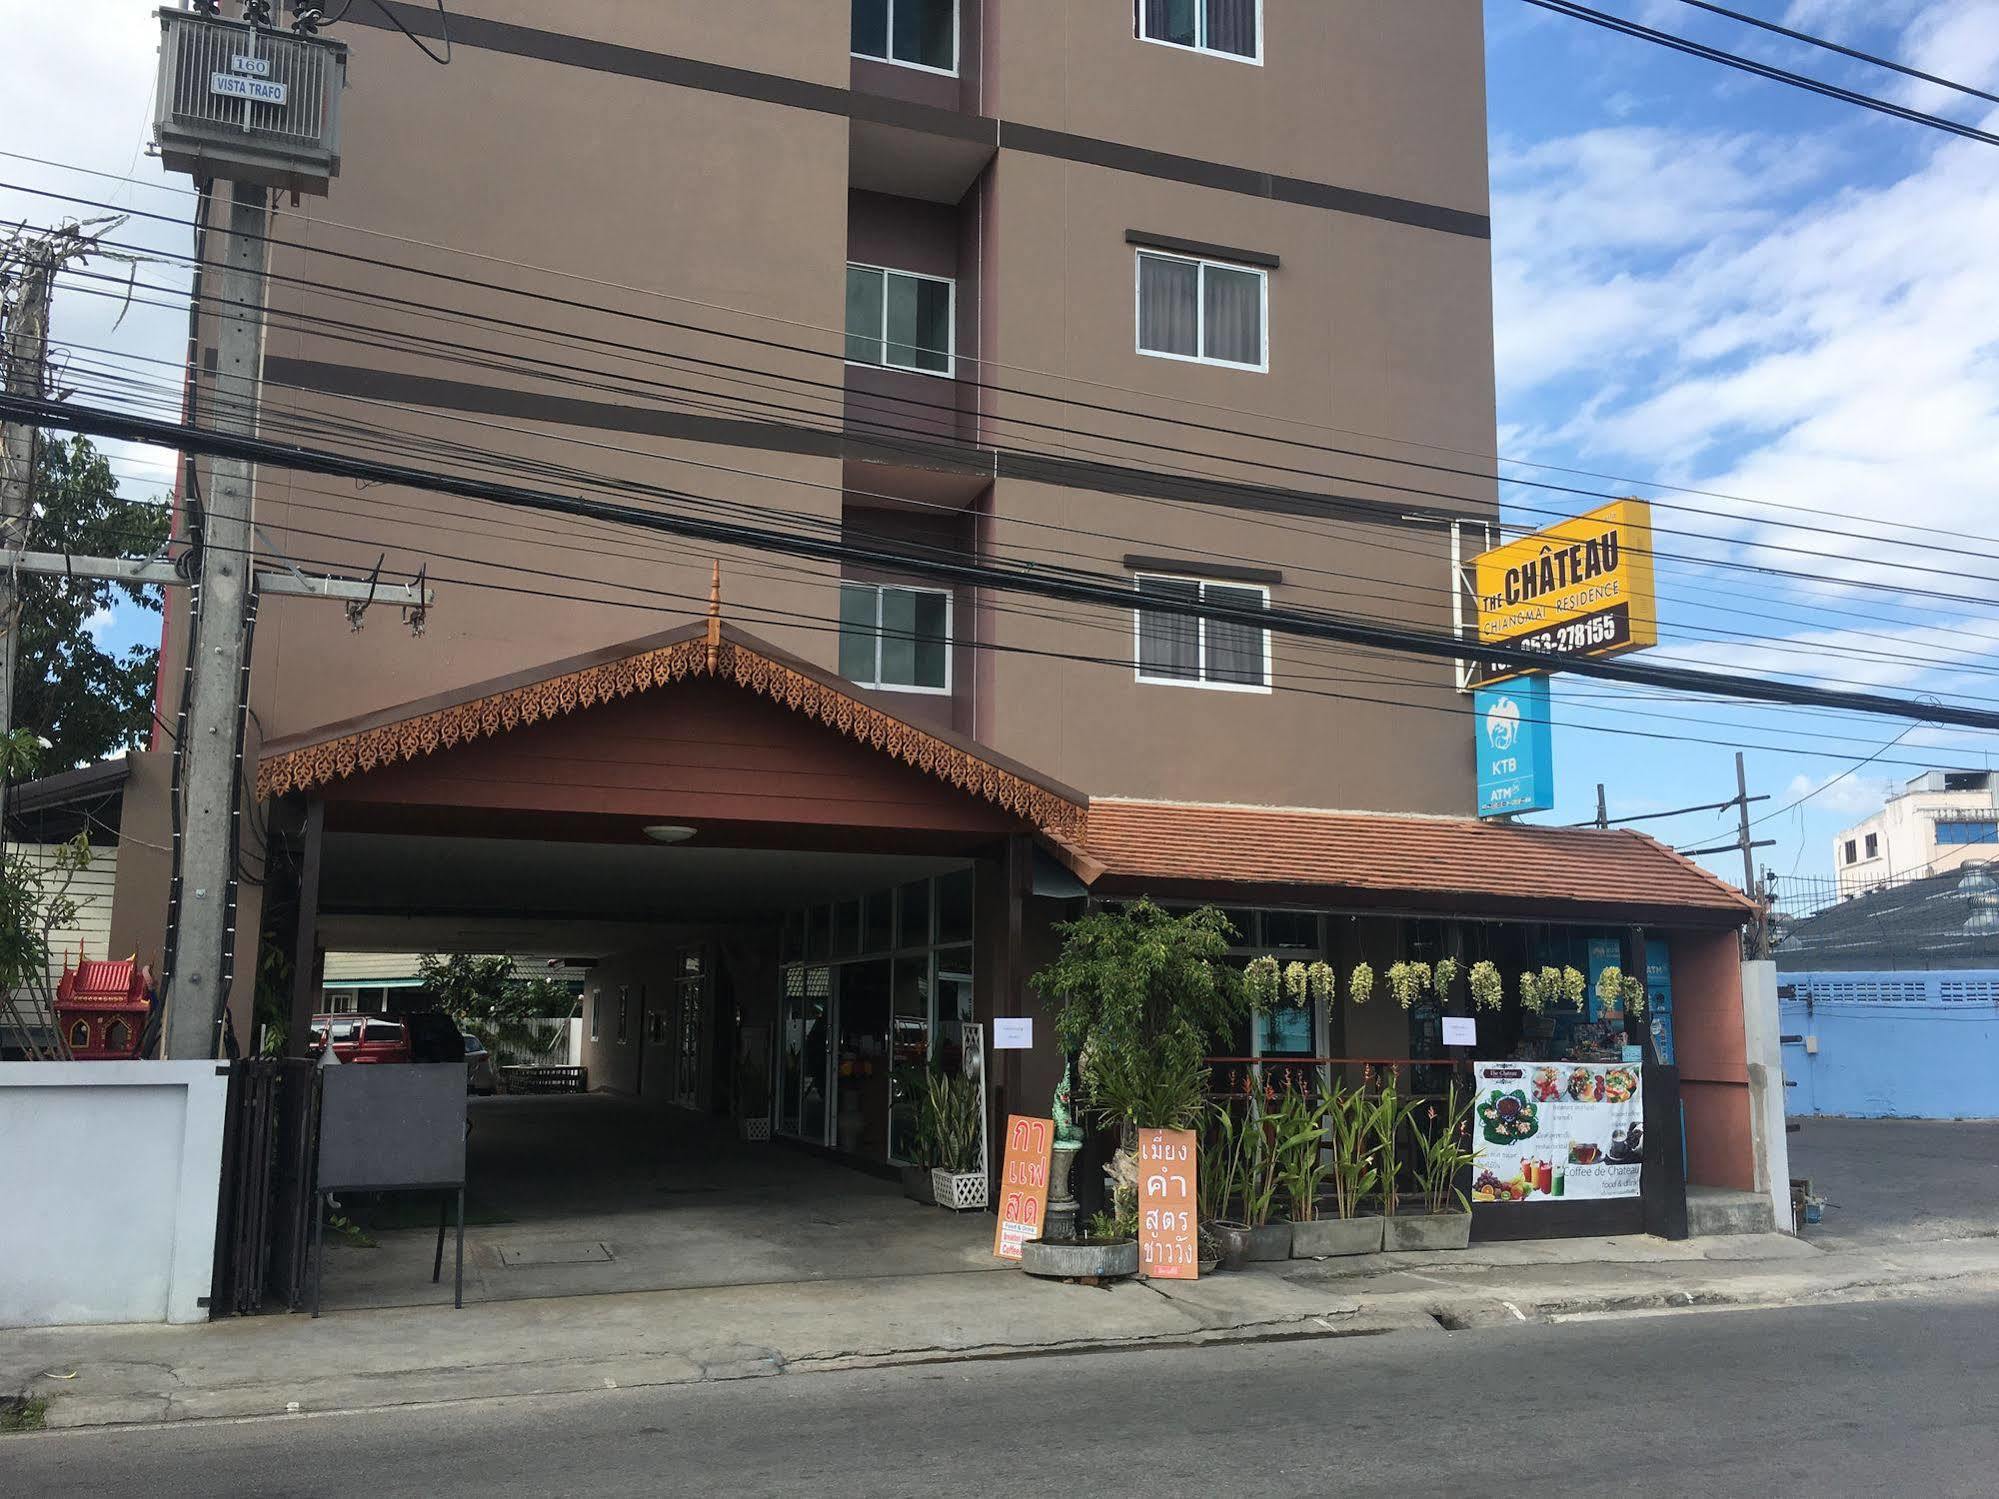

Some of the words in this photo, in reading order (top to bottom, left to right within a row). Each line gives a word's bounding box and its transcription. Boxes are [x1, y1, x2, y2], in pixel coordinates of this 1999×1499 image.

[237, 59, 266, 73] 160
[217, 77, 246, 94] VISTA
[249, 82, 281, 99] TRAFO
[1483, 593, 1502, 613] THE
[1504, 530, 1619, 606] CHÂTEAU
[1484, 606, 1546, 636] CHIANGMAI
[1556, 580, 1619, 613] RESIDENCE
[1492, 757, 1517, 776] KTB
[1491, 787, 1512, 801] ATM
[1012, 1120, 1045, 1153] กา
[1147, 1166, 1187, 1197] คำ
[1563, 1166, 1592, 1177] Coffee
[1594, 1165, 1606, 1176] de
[1607, 1164, 1639, 1175] Chateau
[1145, 1209, 1188, 1238] สูตร
